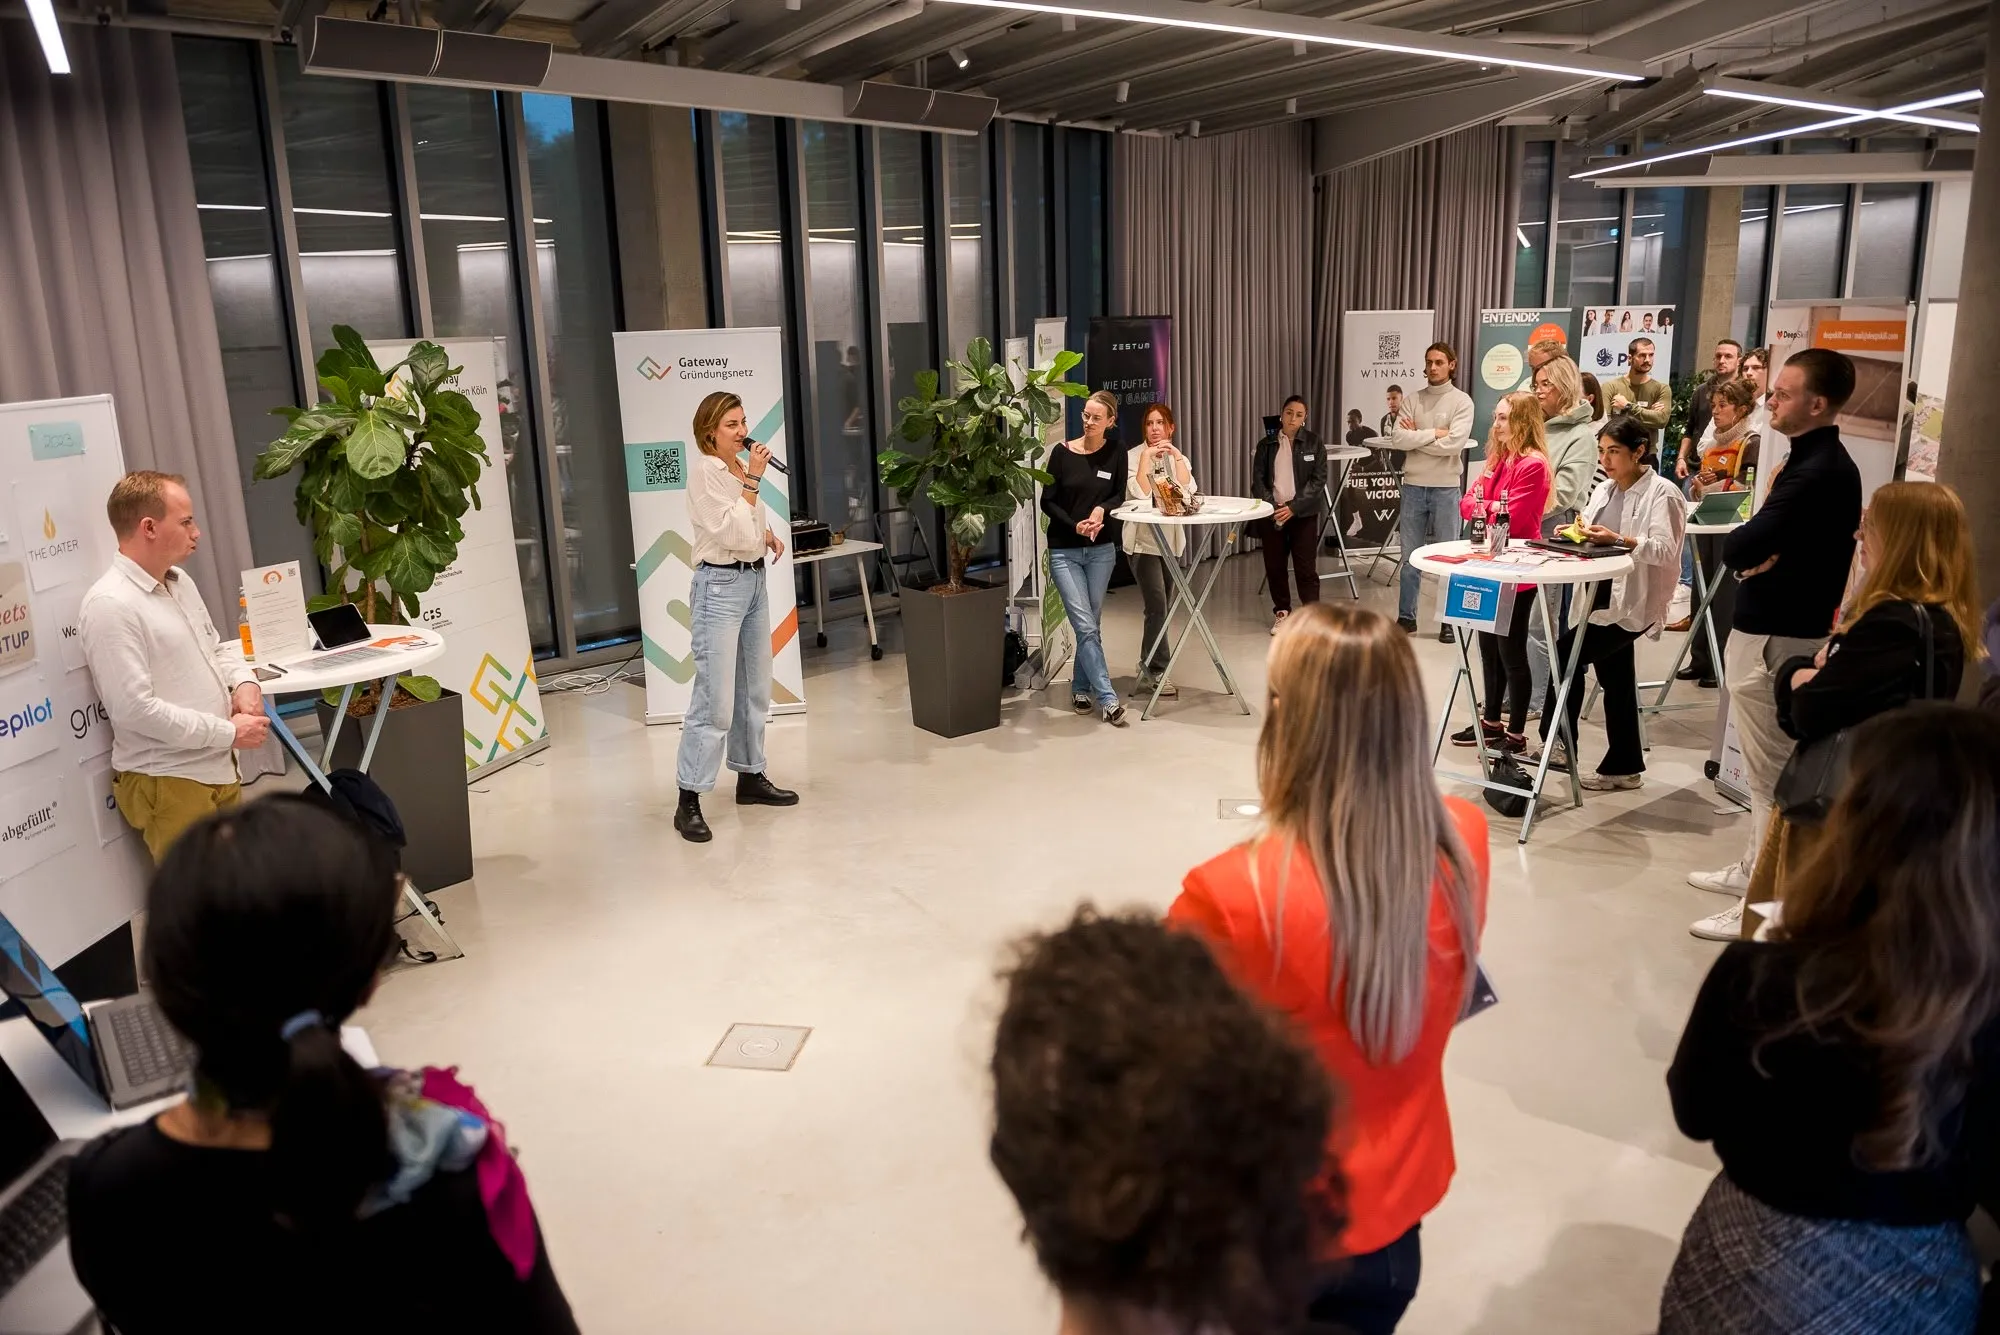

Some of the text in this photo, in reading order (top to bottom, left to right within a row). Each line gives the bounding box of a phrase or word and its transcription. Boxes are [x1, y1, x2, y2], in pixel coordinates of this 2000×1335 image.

[1482, 312, 1541, 324] ENTENDIX
[1112, 342, 1151, 351] ZESTUM
[678, 357, 729, 369] Gateway
[679, 369, 754, 381] Gründungsnetz
[1102, 378, 1153, 391] WIE DUFTET
[471, 385, 488, 397] Köln
[1126, 391, 1161, 406] GAME?
[1346, 478, 1369, 488] FUEL
[29, 539, 79, 562] THE OATER
[0, 604, 27, 625] ets
[0, 630, 30, 654] TUP
